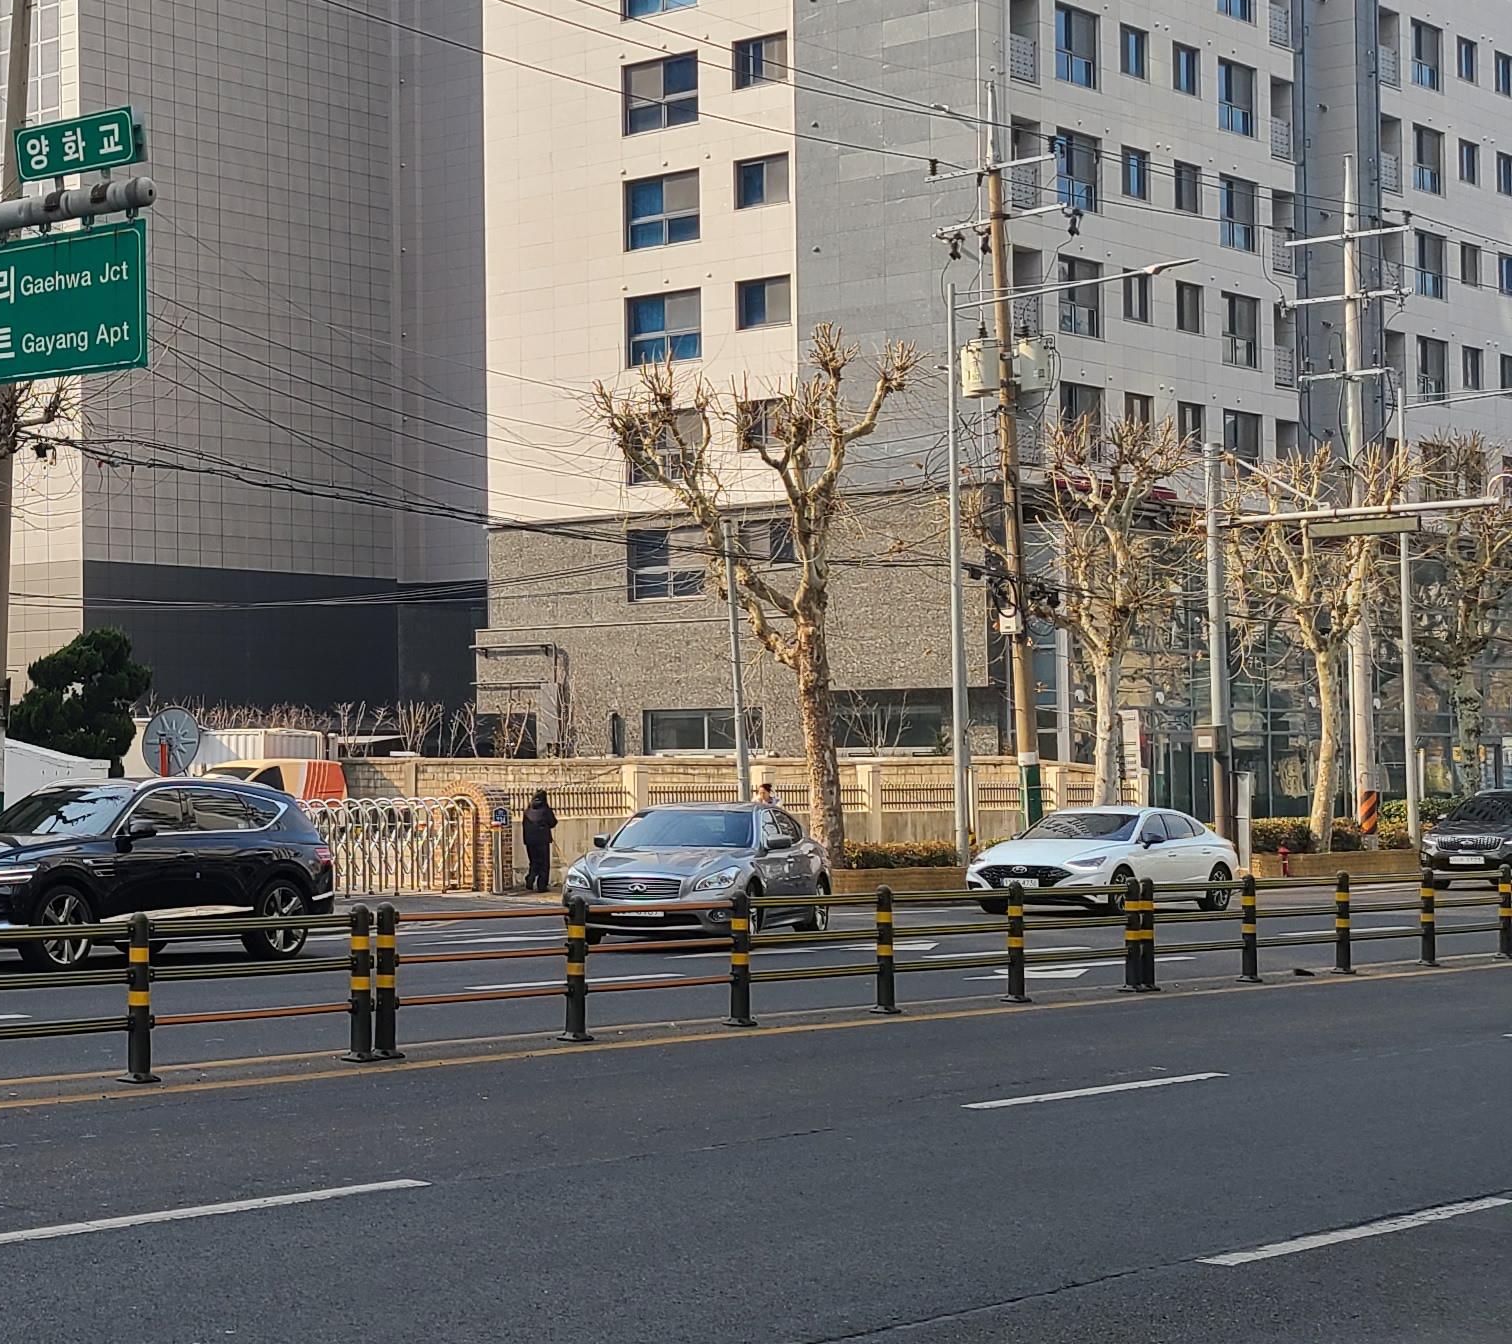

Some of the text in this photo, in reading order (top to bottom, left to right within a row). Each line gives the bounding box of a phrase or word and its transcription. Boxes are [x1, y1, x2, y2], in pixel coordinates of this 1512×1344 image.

[20, 270, 92, 296] Gaehwa
[99, 261, 128, 283] Jct
[22, 331, 88, 356] Gayang
[96, 321, 129, 347] Apt
